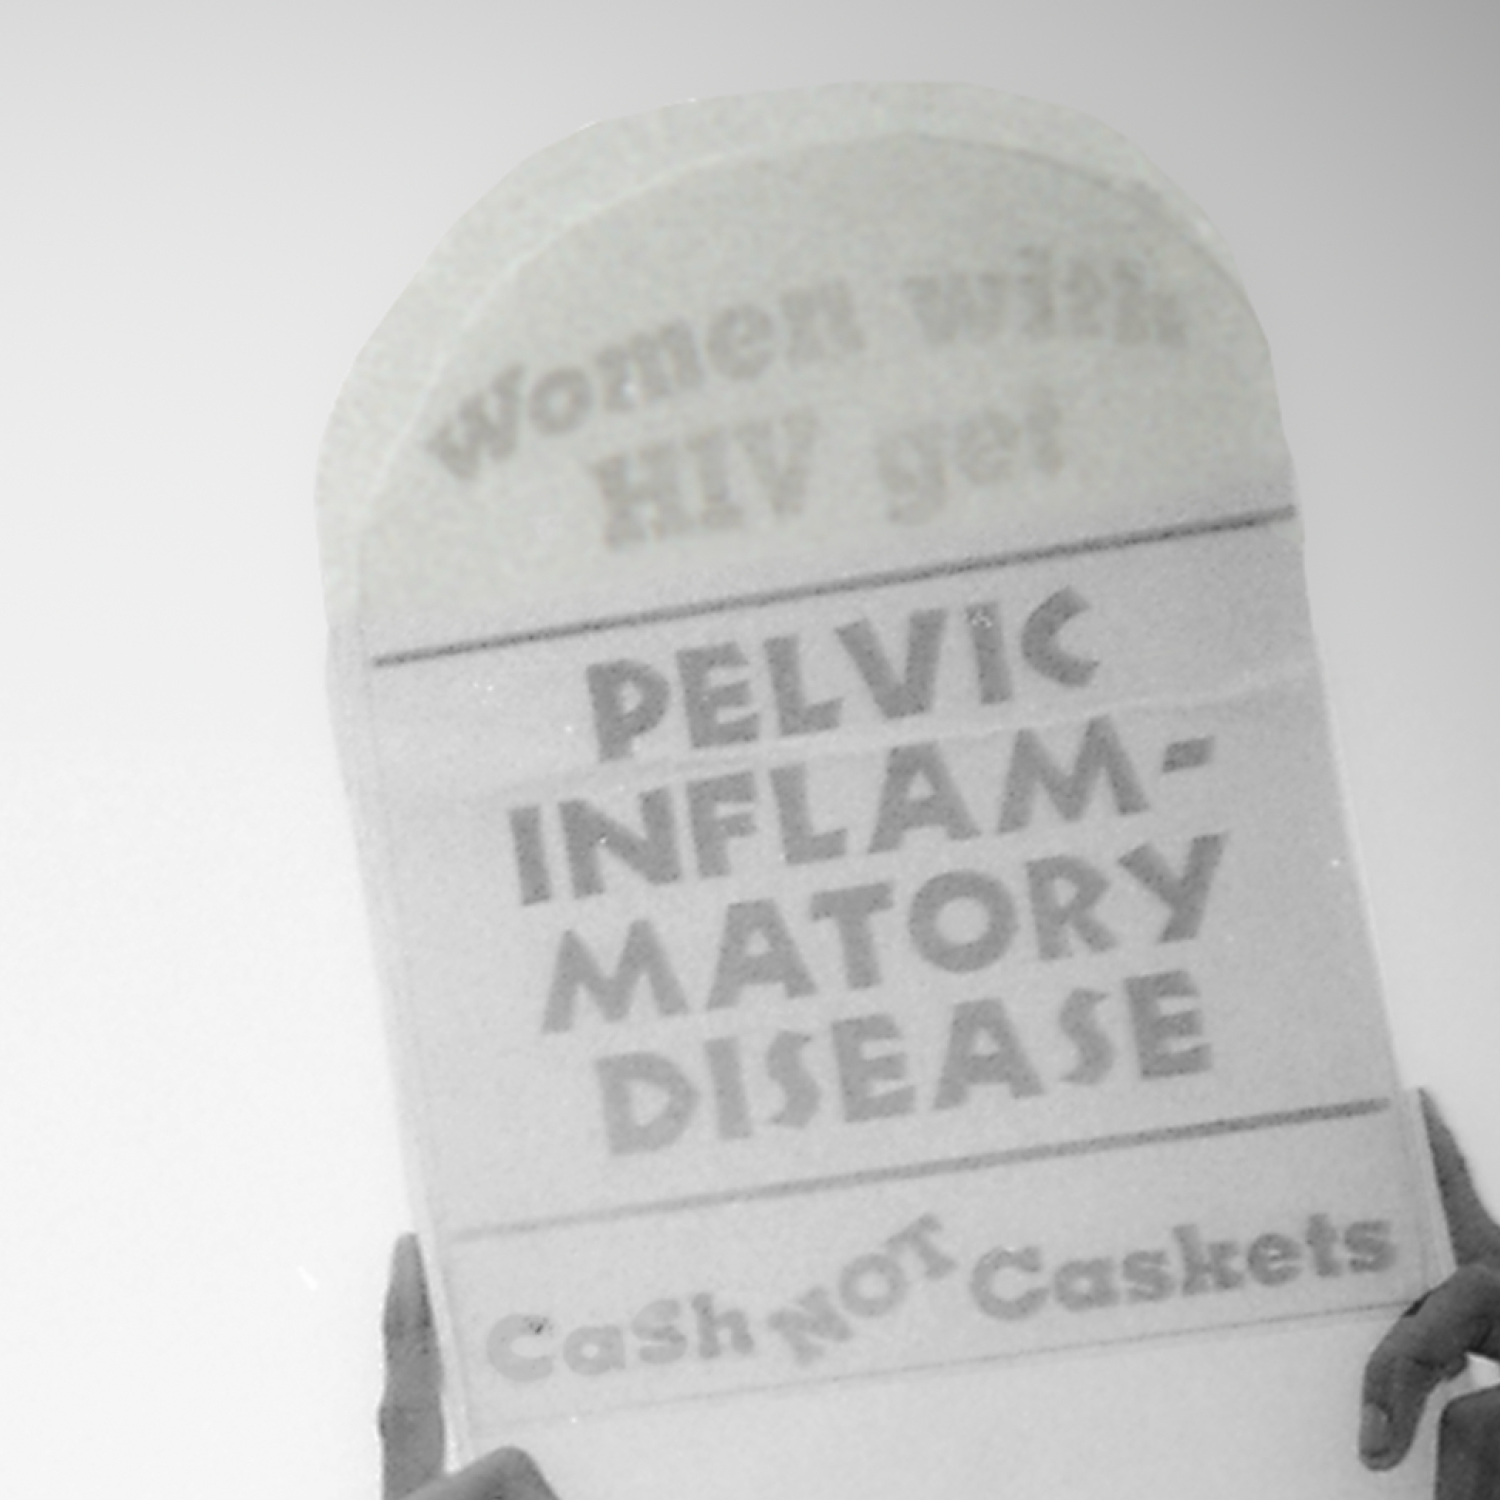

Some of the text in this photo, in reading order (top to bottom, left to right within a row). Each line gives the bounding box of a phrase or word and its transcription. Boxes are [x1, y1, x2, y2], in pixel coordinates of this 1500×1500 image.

[425, 242, 1190, 484] Women with
[589, 381, 1066, 554] HIV get
[585, 586, 1102, 763] PELVIC
[507, 713, 1217, 907] INFLAM-
[540, 831, 1229, 1035] MATORY
[593, 968, 1214, 1158] DISEASE
[766, 1213, 959, 1366] NOT
[969, 1213, 1399, 1322] Caskets
